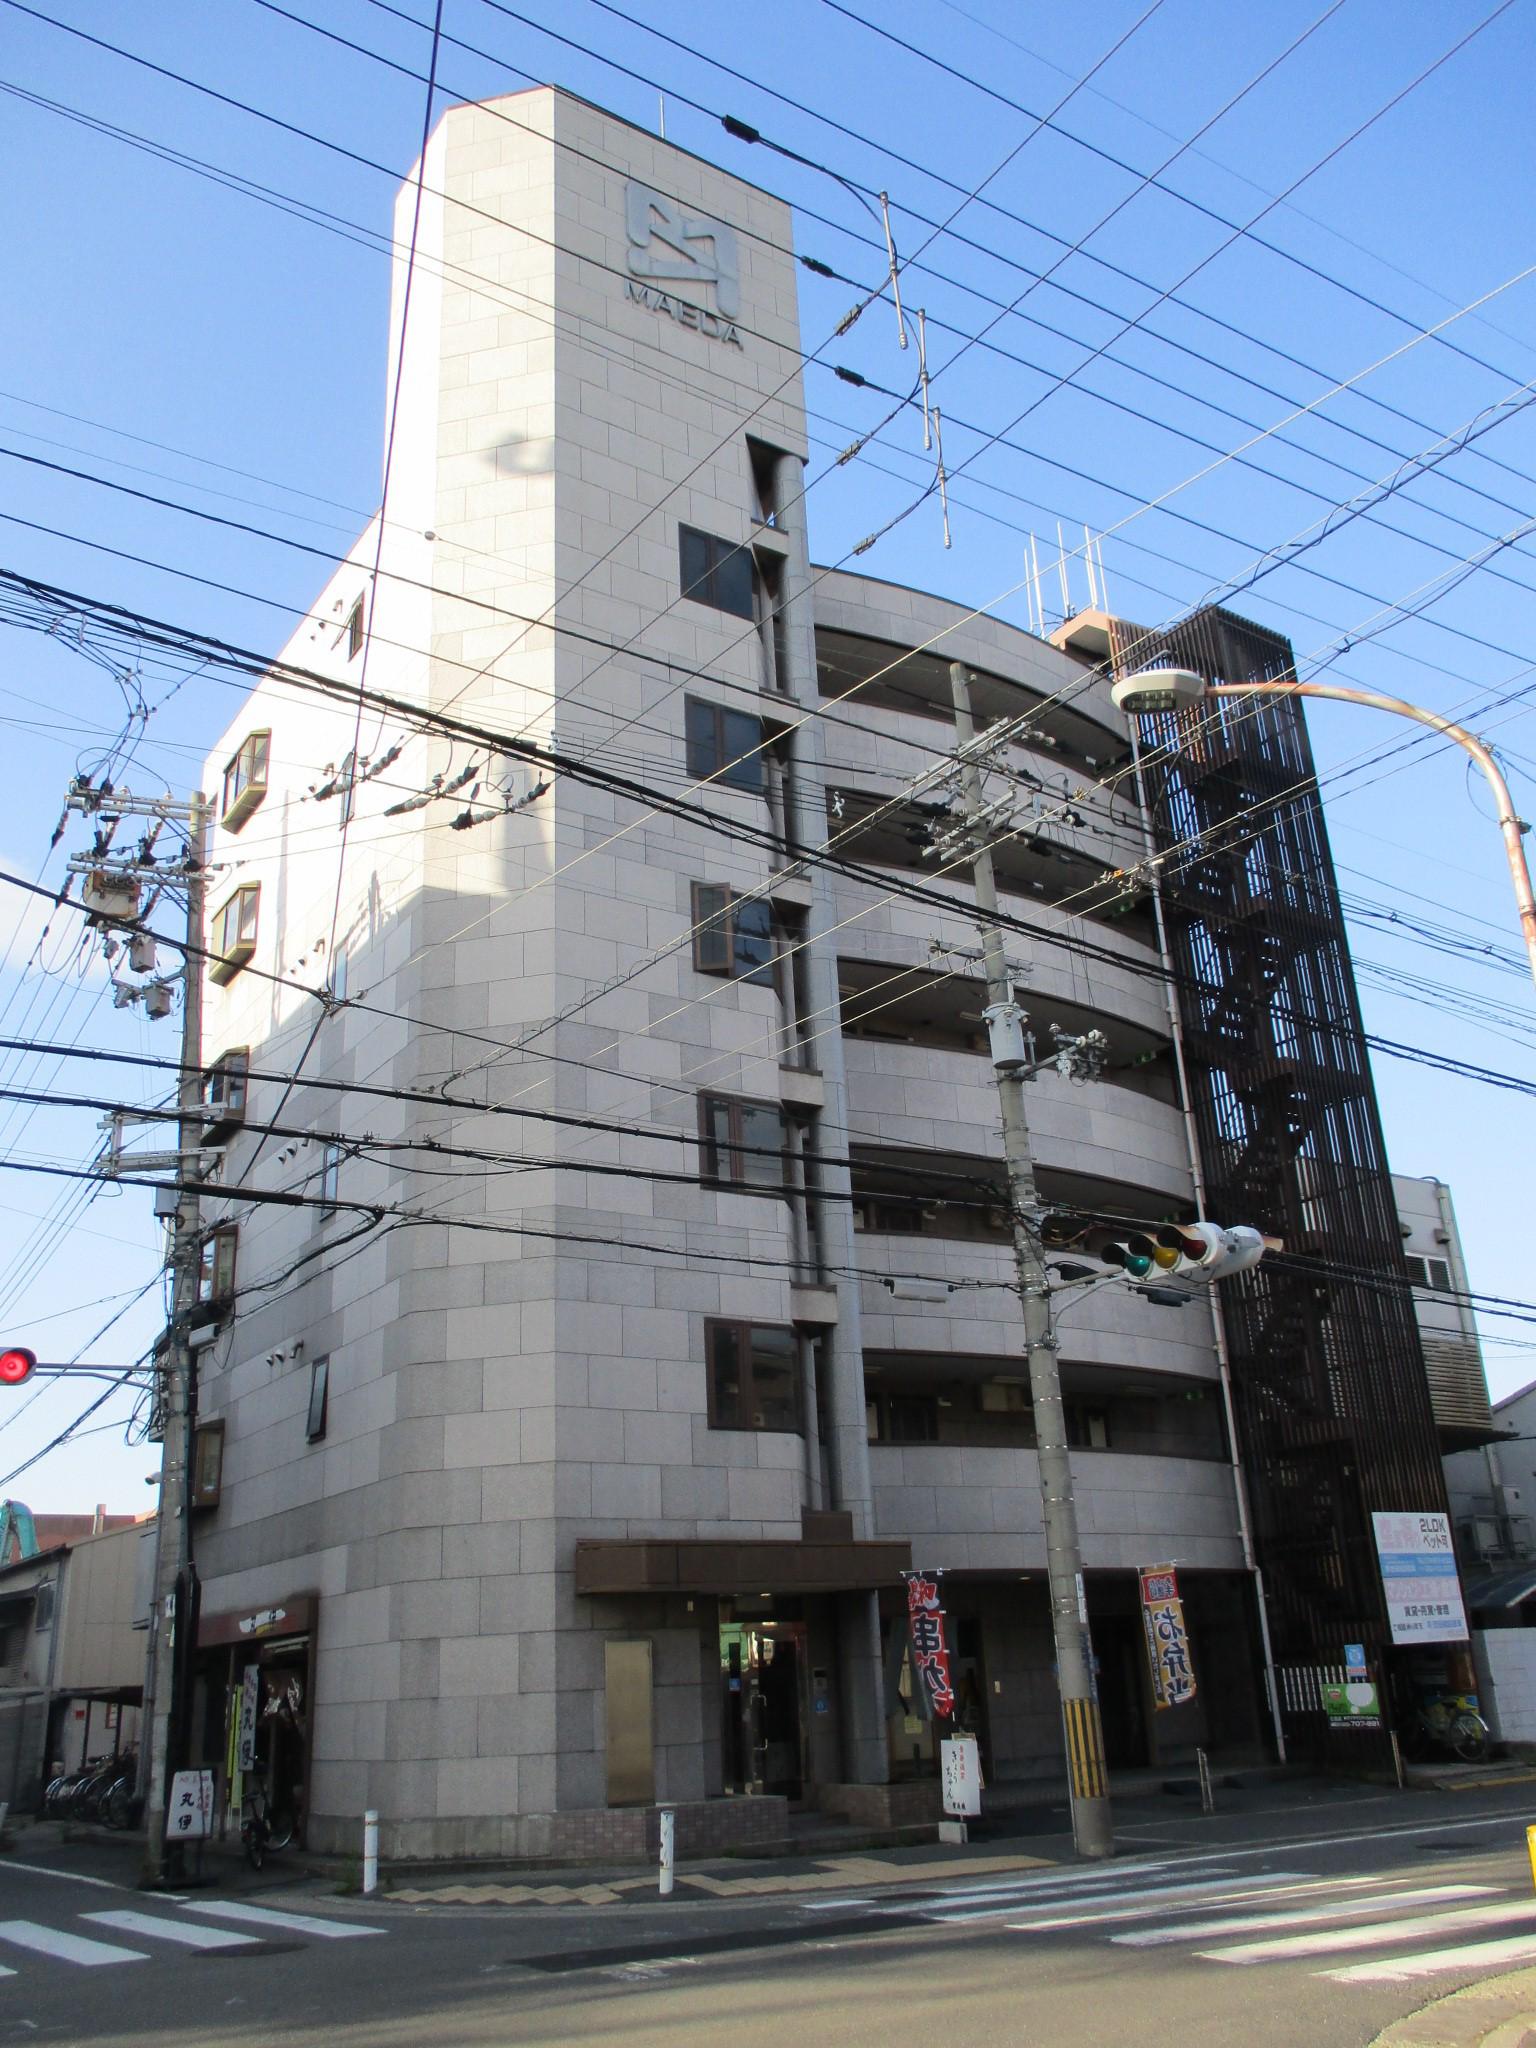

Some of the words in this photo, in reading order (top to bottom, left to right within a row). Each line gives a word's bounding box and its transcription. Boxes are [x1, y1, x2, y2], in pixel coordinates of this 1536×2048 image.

[624, 279, 744, 351] MAEDA
[1420, 1518, 1446, 1533] 2LDK
[178, 1791, 195, 1831] 丸伊
